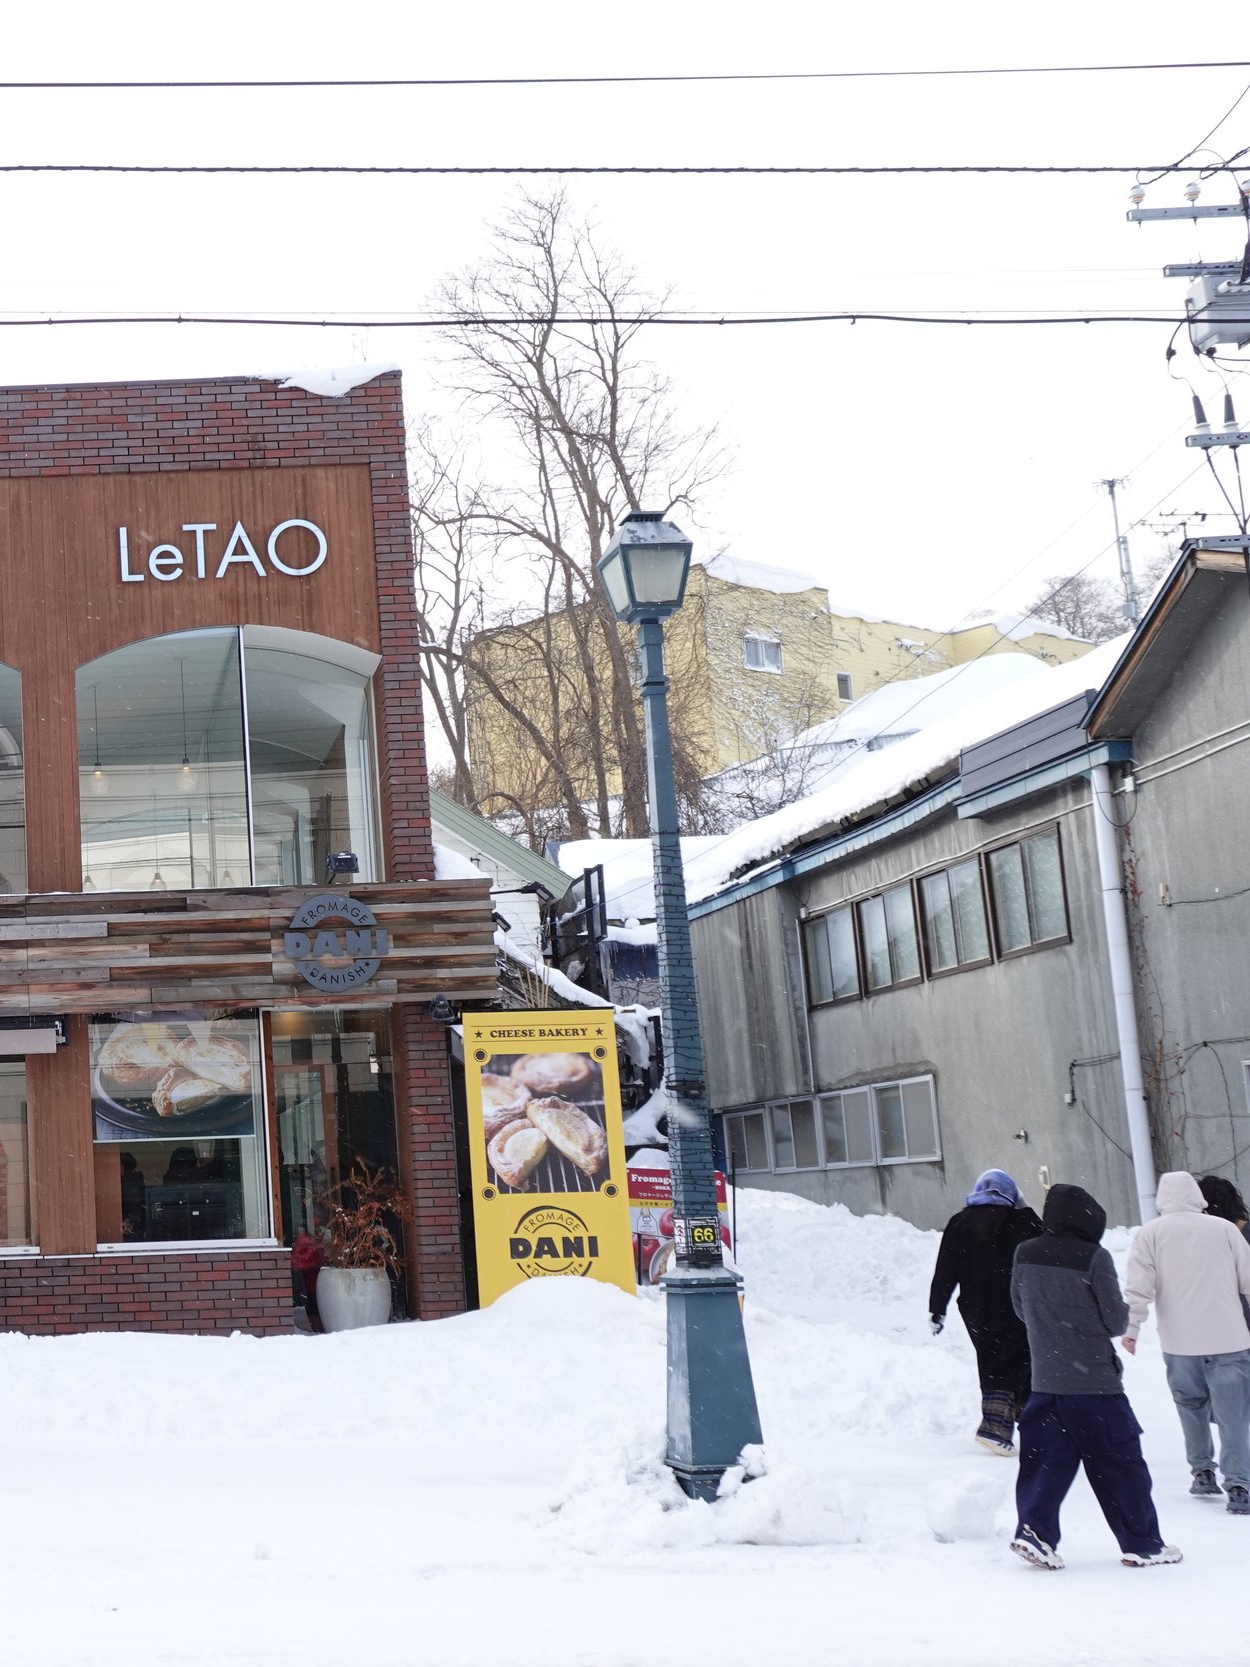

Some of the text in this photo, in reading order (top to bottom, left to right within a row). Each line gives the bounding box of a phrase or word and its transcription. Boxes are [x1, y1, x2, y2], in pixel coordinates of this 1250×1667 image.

[119, 518, 328, 582] LeTAO
[301, 901, 369, 927] FROMAGE
[284, 929, 390, 958] DANI
[309, 965, 366, 984] DANISH
[490, 1028, 588, 1038] CHEESE BAKERY
[631, 1174, 672, 1185] Fromag
[524, 1209, 580, 1233] FROMAGE
[693, 1227, 715, 1242] 66
[509, 1235, 599, 1260] DANI
